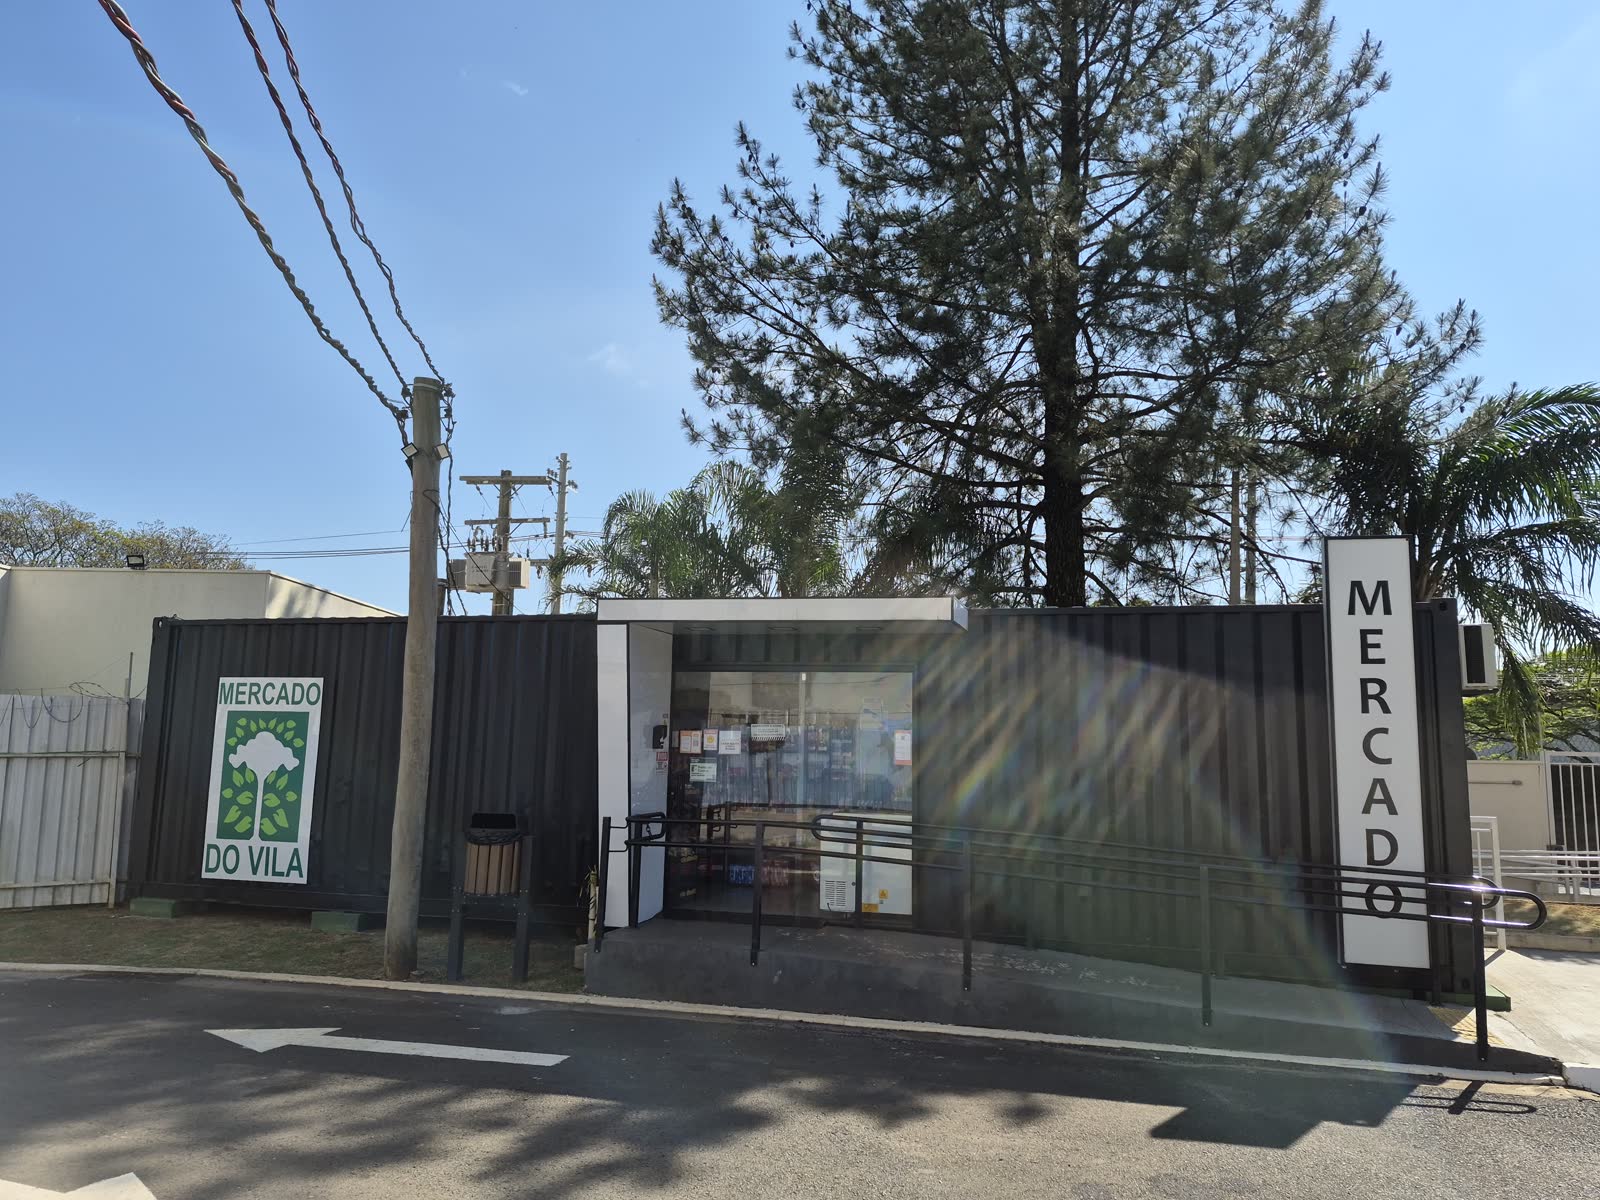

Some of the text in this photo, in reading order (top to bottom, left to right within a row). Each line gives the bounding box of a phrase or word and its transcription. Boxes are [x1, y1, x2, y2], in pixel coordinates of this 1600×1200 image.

[219, 682, 321, 705] MERCADO
[1348, 580, 1403, 919] MERCADO
[205, 844, 304, 878] DO VILA
